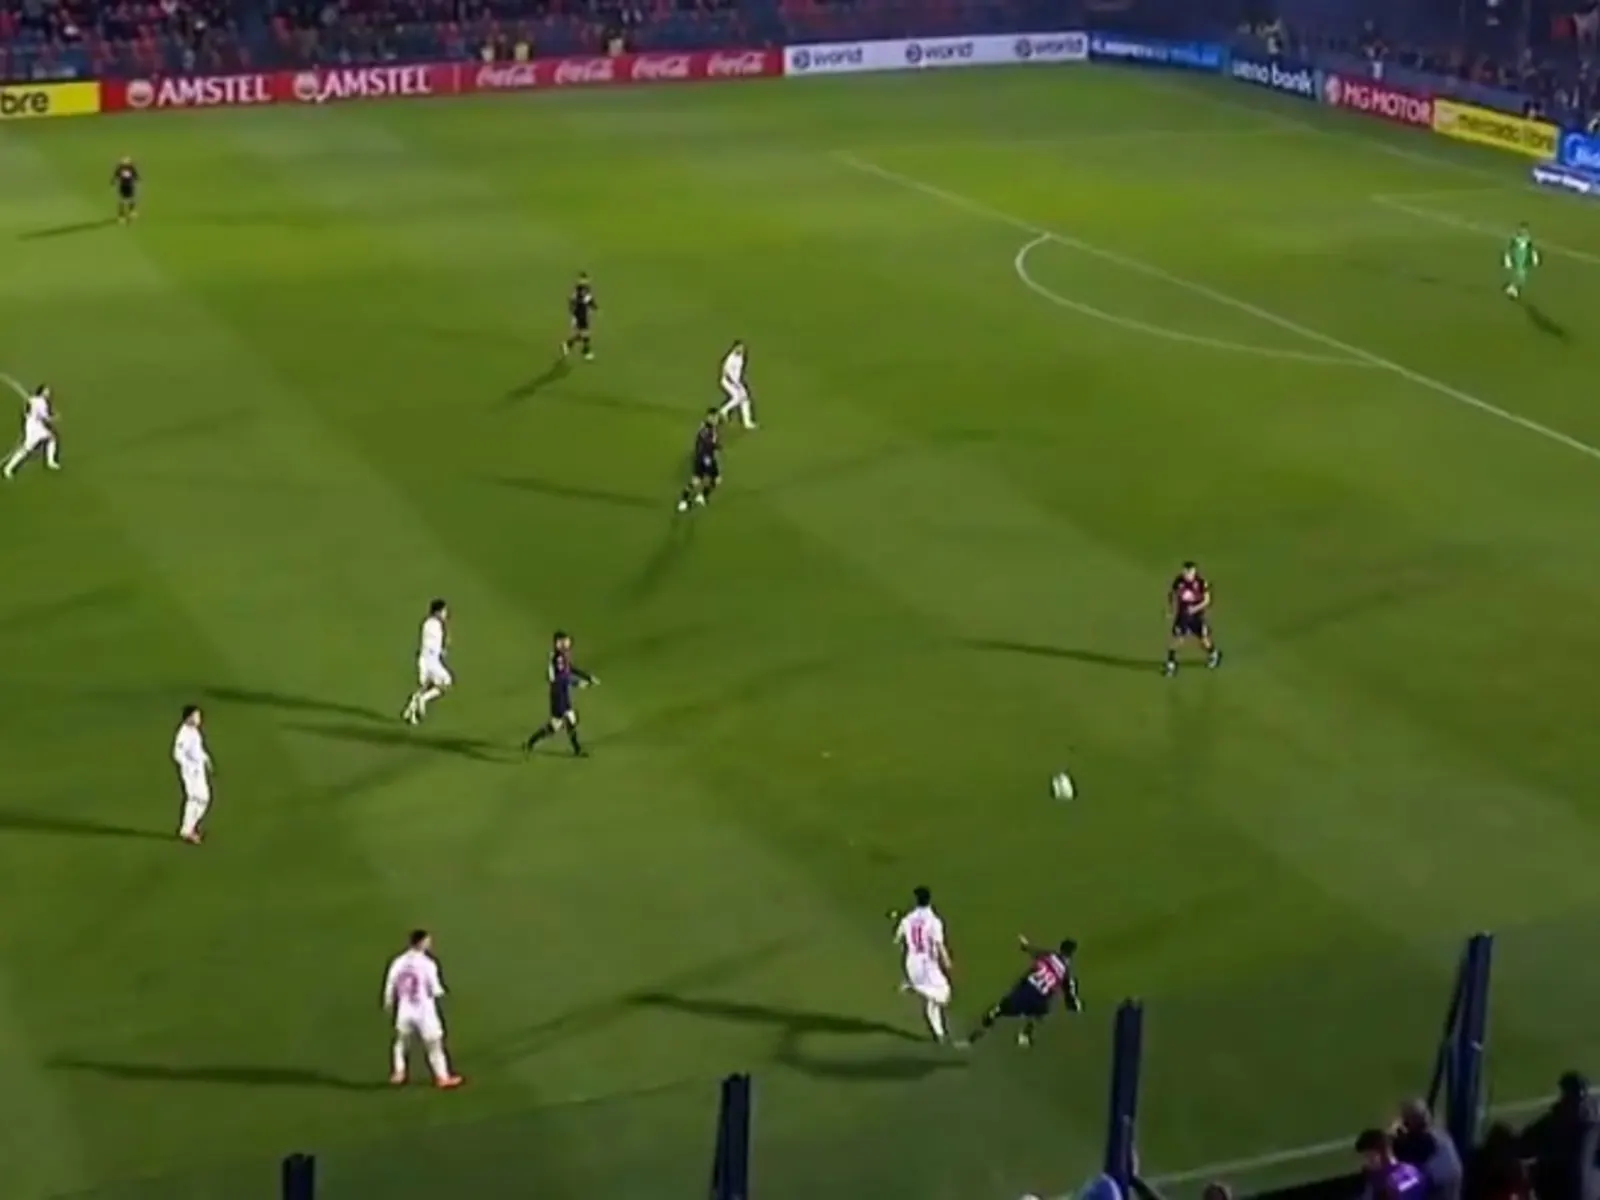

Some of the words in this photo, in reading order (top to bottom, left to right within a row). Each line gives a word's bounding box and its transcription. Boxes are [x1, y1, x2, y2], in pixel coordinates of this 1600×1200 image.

[813, 46, 864, 67] world
[924, 41, 975, 60] world
[158, 73, 272, 107] AMSTEL
[322, 64, 432, 98] AMSTEL
[1271, 62, 1313, 95] bank
[1343, 82, 1370, 110] MG
[1371, 91, 1431, 124] MOTOR
